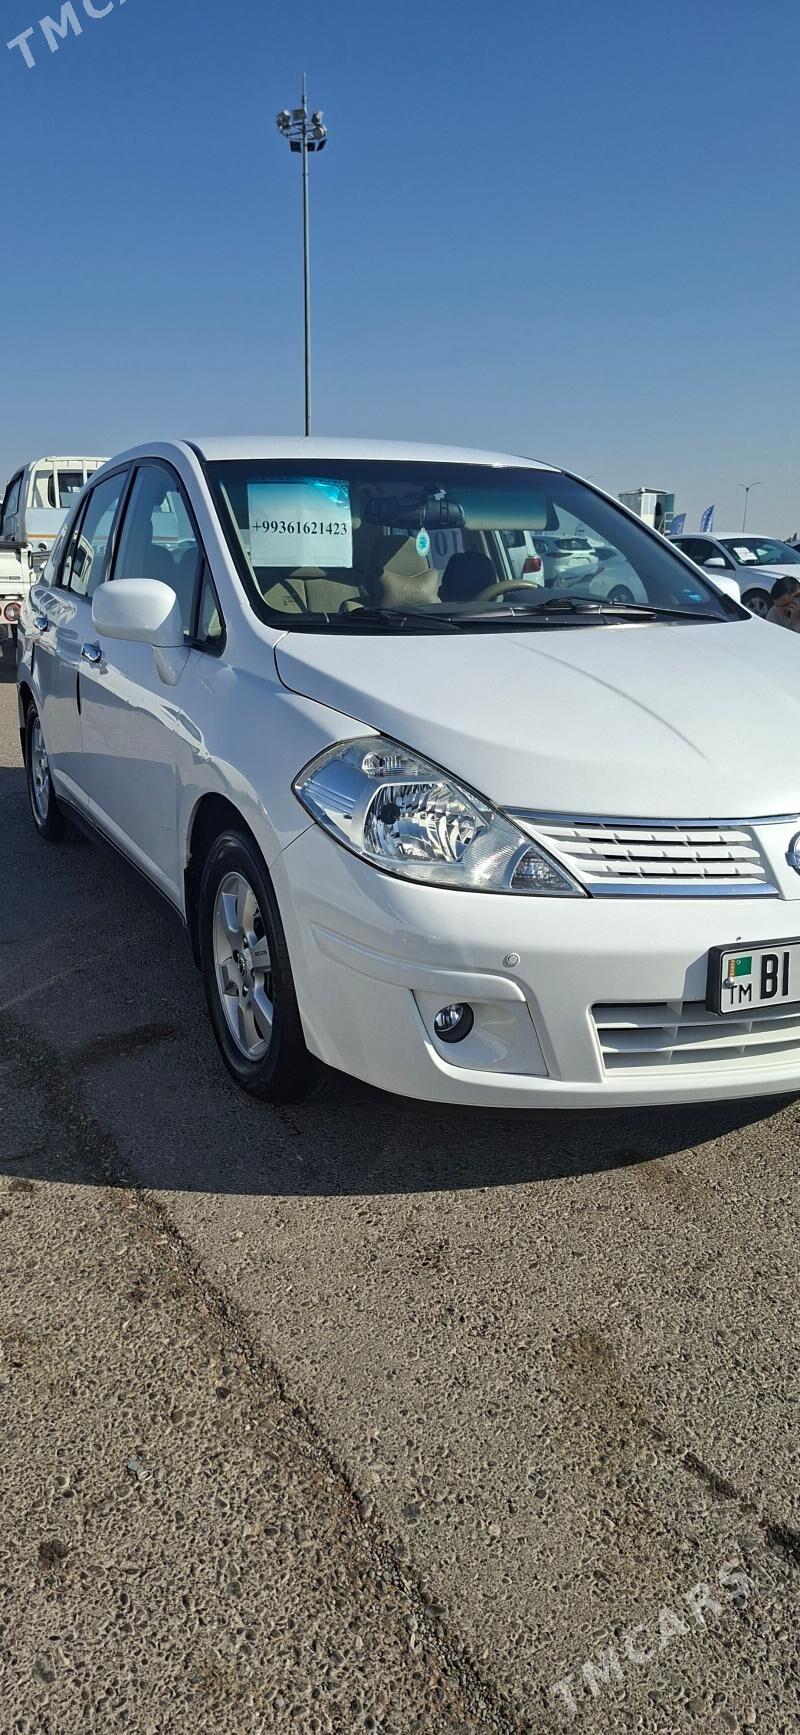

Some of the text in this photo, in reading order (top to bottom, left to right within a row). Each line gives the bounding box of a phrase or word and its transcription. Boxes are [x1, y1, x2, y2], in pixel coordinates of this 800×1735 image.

[252, 520, 348, 535] +99361621423
[760, 952, 790, 999] BI
[728, 983, 752, 1004] TM
